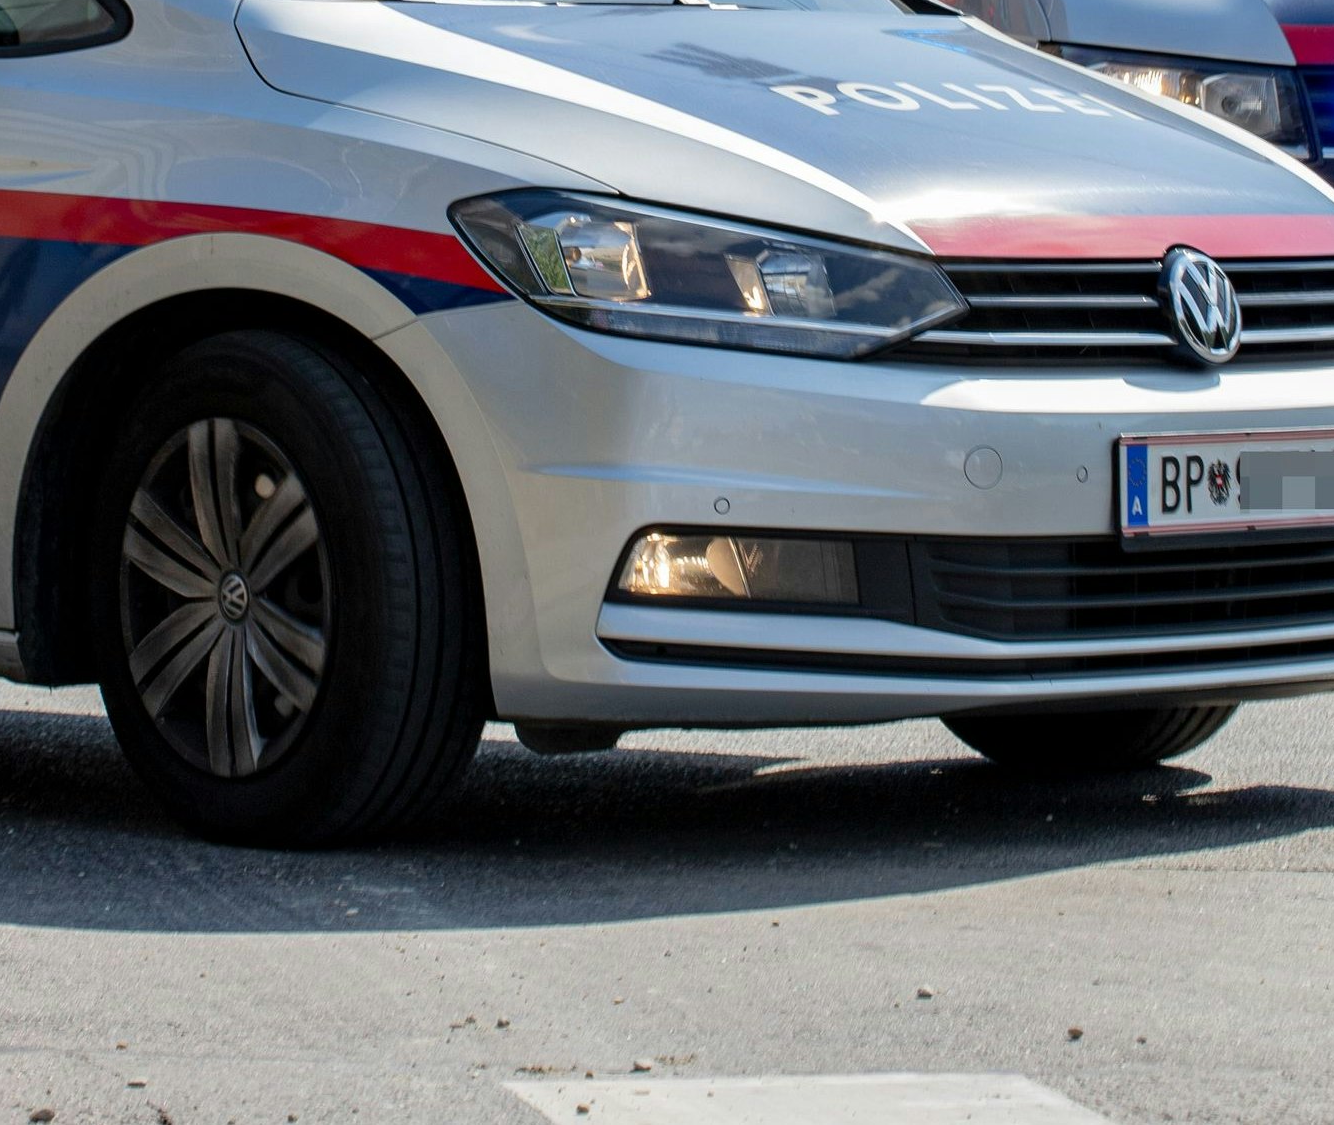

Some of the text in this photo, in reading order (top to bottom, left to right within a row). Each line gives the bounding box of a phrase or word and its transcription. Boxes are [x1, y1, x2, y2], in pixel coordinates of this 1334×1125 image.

[770, 81, 1146, 121] POLIZEI
[1170, 251, 1240, 361] VW
[1132, 496, 1143, 516] A
[1161, 455, 1205, 515] BP
